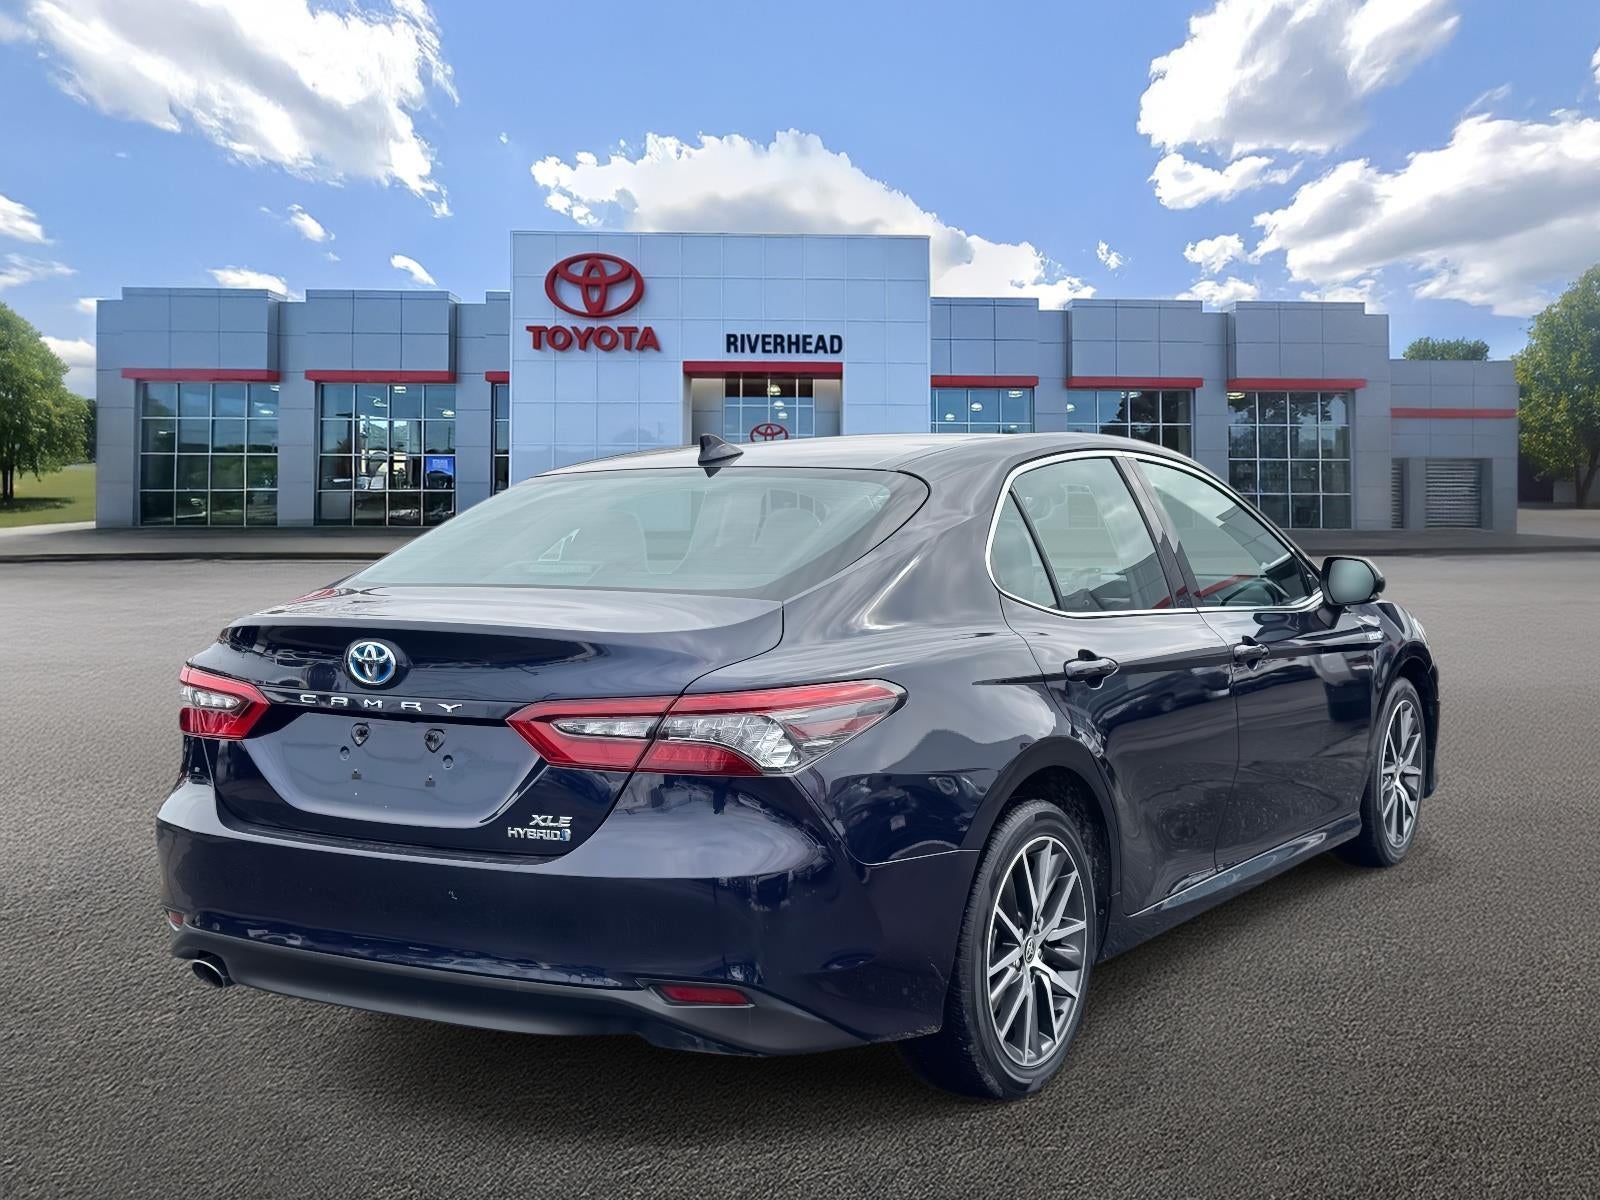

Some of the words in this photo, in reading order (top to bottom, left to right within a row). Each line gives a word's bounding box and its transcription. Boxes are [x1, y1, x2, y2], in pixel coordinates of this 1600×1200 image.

[526, 325, 661, 352] TOYOTA
[726, 333, 843, 354] RIVERHEAD
[300, 694, 463, 713] CAMRY
[529, 814, 572, 828] XLE
[507, 827, 561, 841] HYBRID
